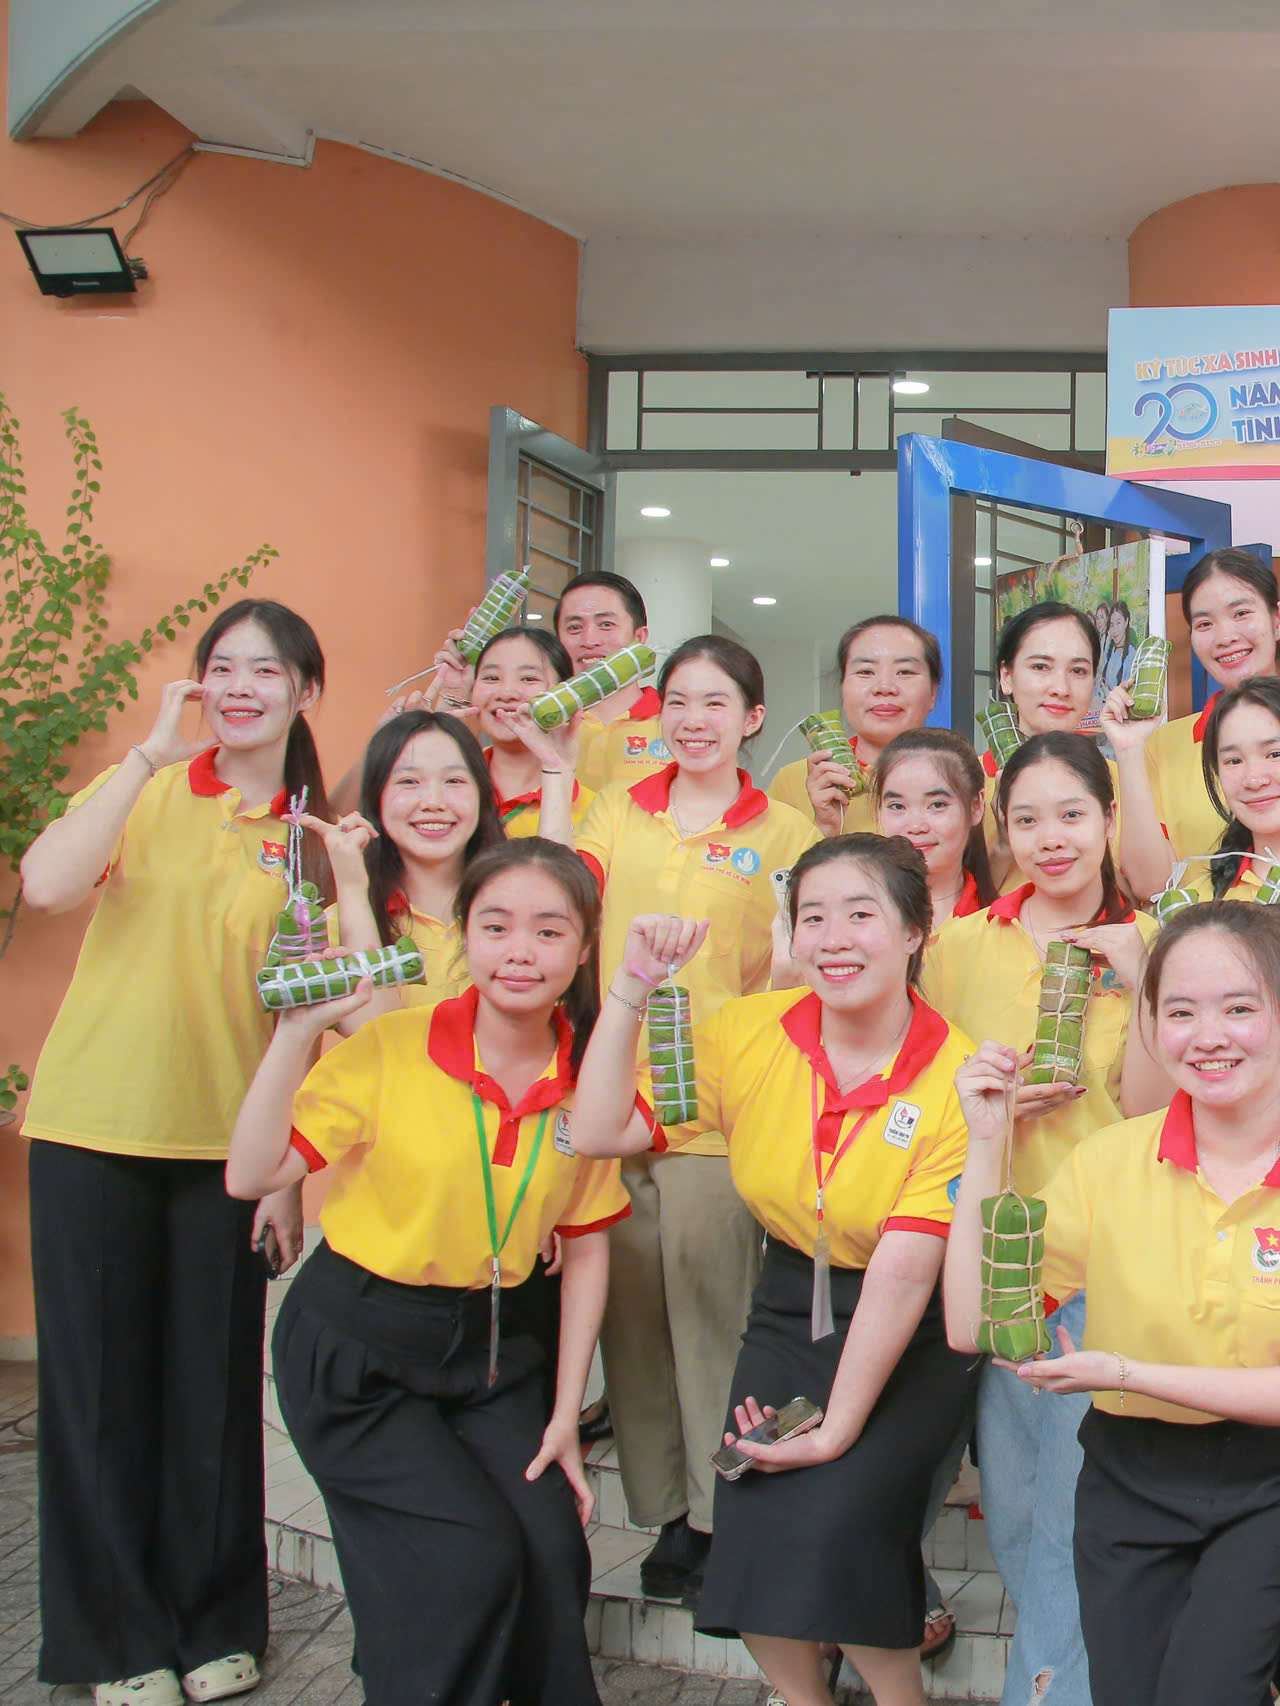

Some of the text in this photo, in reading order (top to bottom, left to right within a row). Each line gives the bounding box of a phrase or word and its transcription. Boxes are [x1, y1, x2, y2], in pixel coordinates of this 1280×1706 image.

[1136, 359, 1161, 381] KÝ
[1165, 355, 1200, 378] TÚC
[1235, 348, 1279, 371] SINH
[1134, 382, 1218, 445] 20
